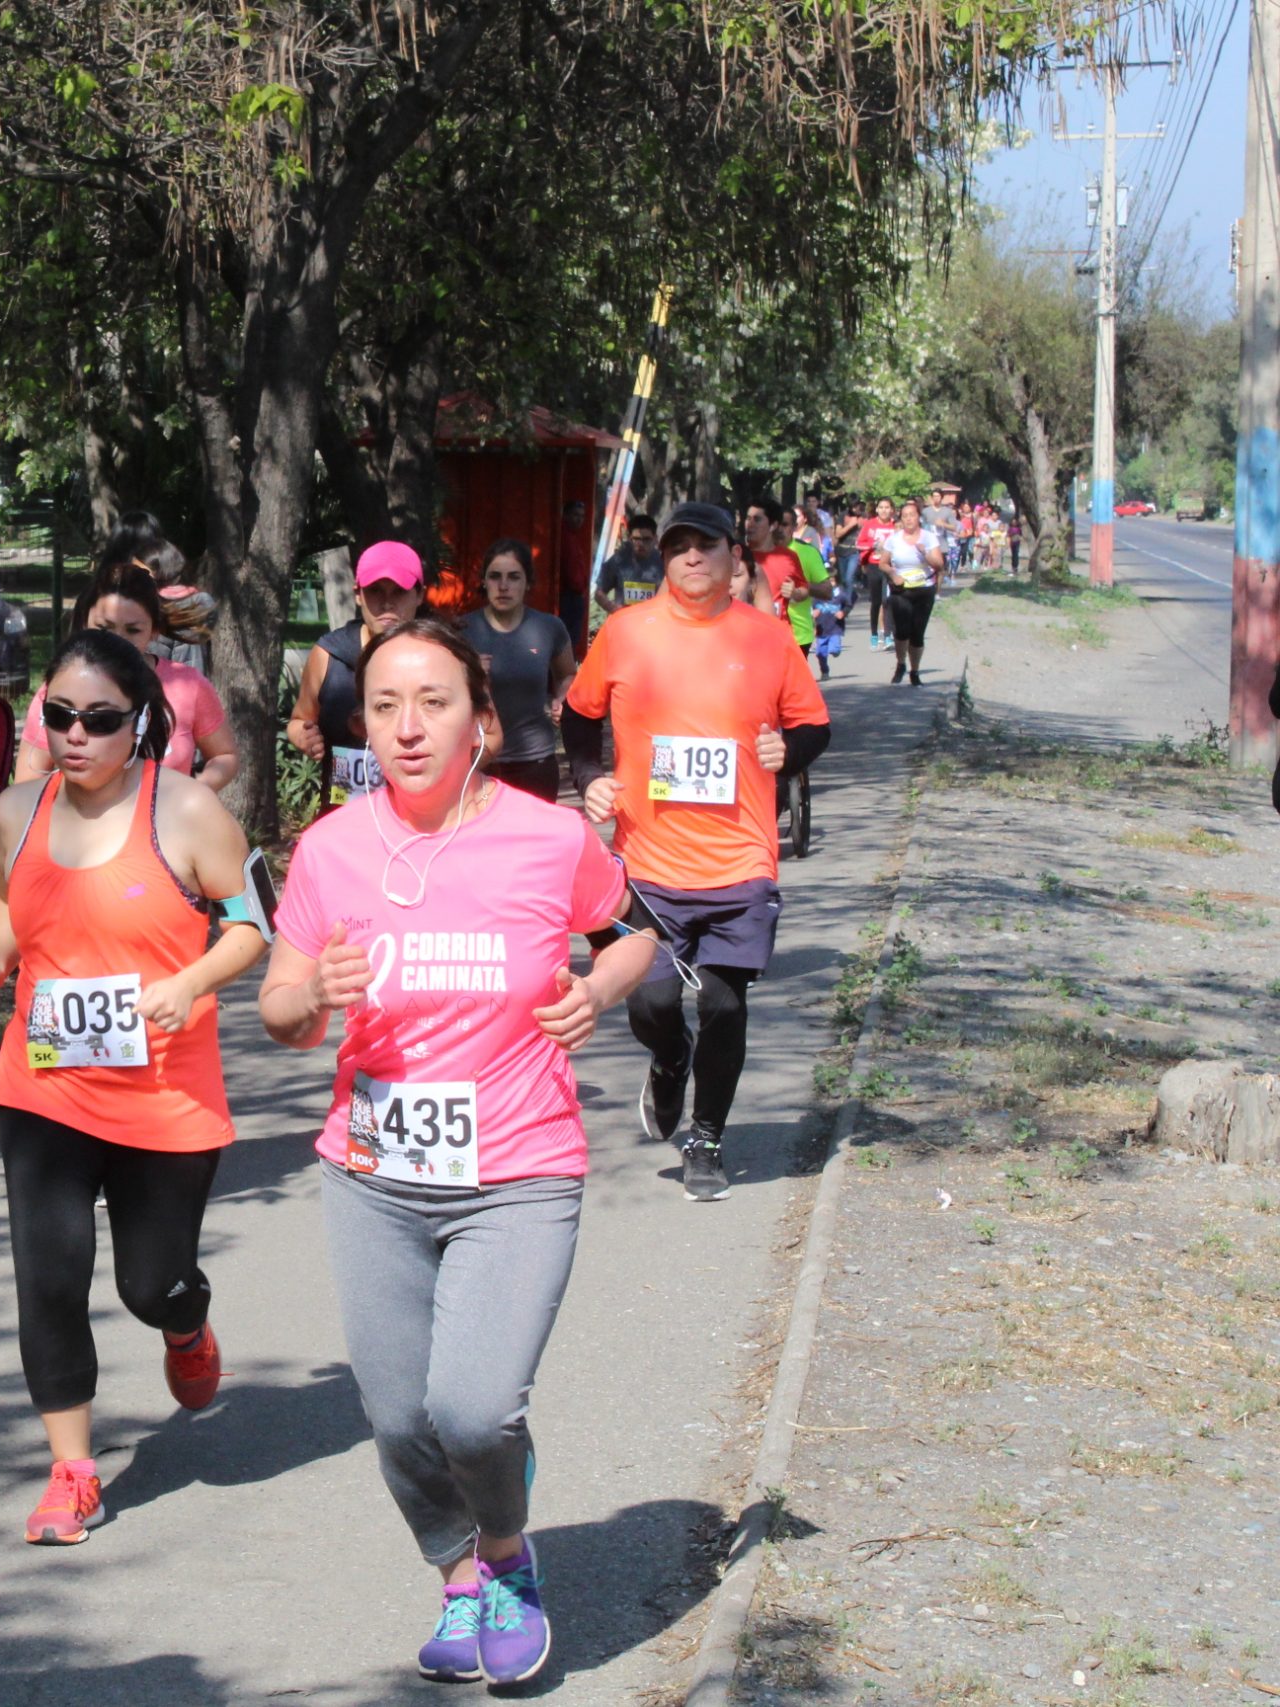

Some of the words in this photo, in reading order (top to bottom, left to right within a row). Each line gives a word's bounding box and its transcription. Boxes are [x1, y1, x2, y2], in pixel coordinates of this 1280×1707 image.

[353, 758, 383, 788] 03
[683, 746, 729, 779] 193
[653, 788, 667, 796] 5K
[402, 932, 507, 961] CORRIDA
[401, 965, 507, 992] CAMINATA
[62, 988, 139, 1035] 035
[403, 995, 508, 1013] AVON
[34, 1053, 53, 1062] 5K
[382, 1097, 472, 1148] 435
[350, 1152, 375, 1169] 10K
